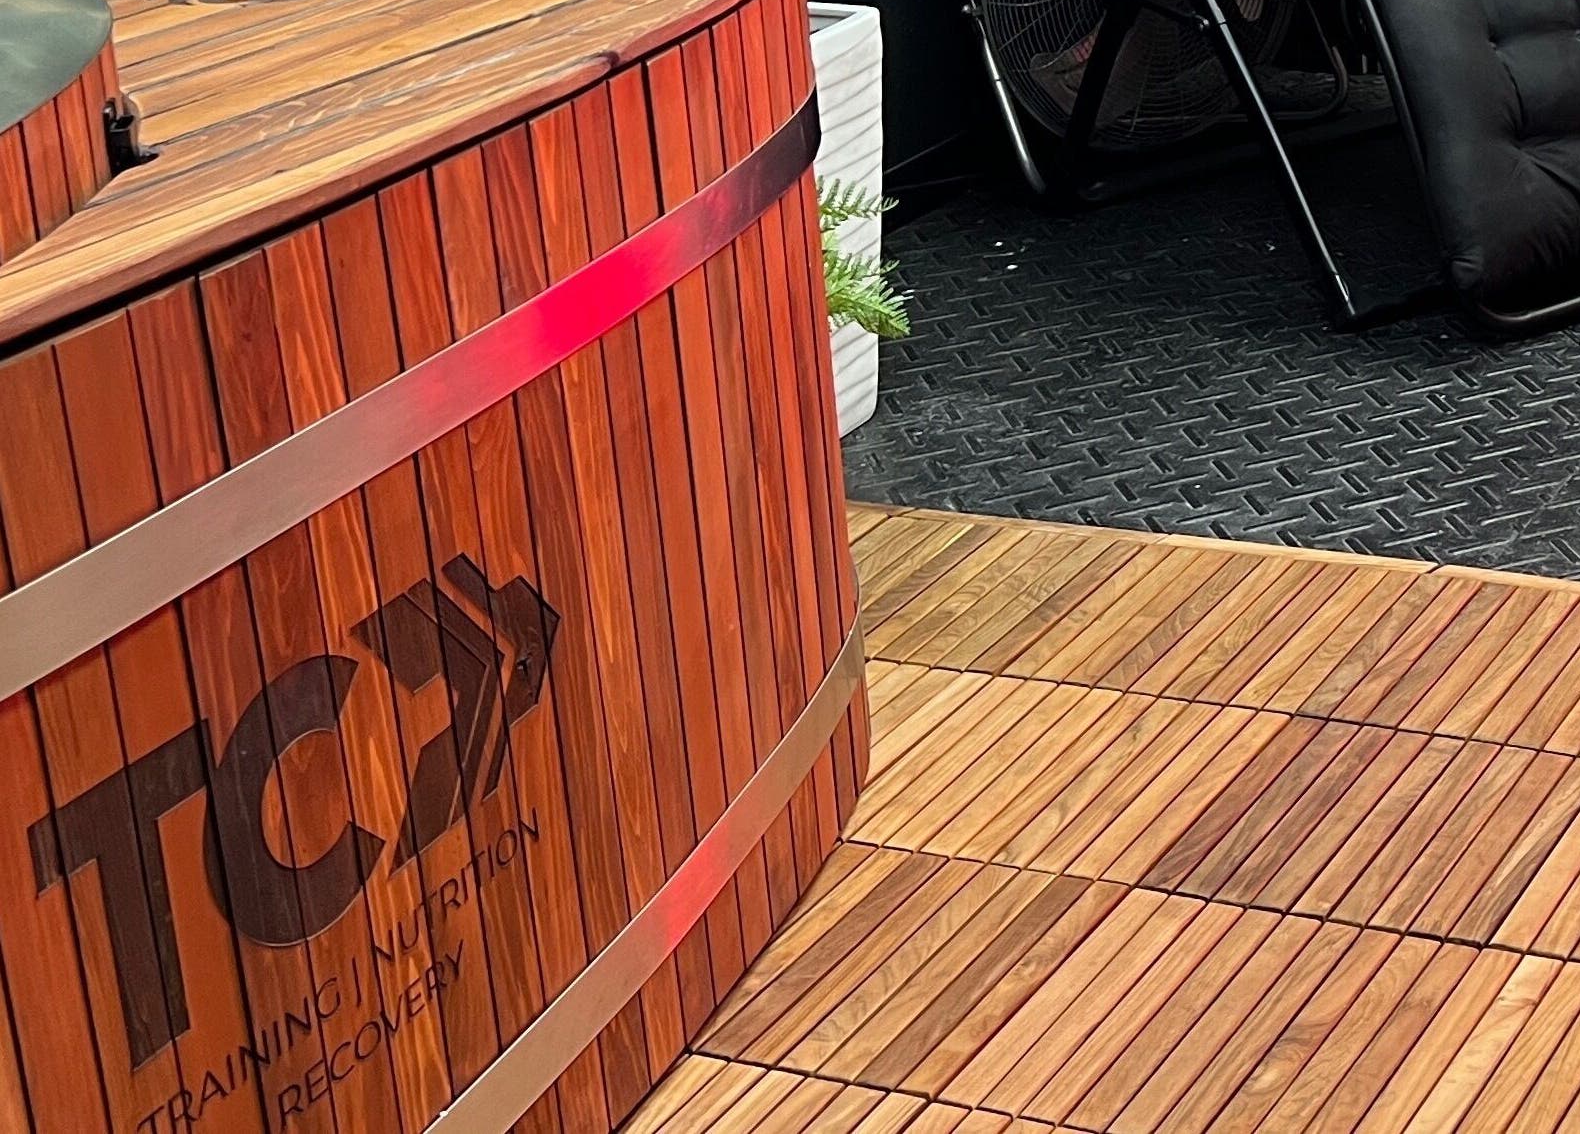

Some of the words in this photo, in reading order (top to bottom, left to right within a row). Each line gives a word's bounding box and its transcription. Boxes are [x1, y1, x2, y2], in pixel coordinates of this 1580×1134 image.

[137, 976, 341, 1134] TRAINING
[373, 807, 541, 964] NUTRITION
[277, 938, 466, 1132] RECOVERY
